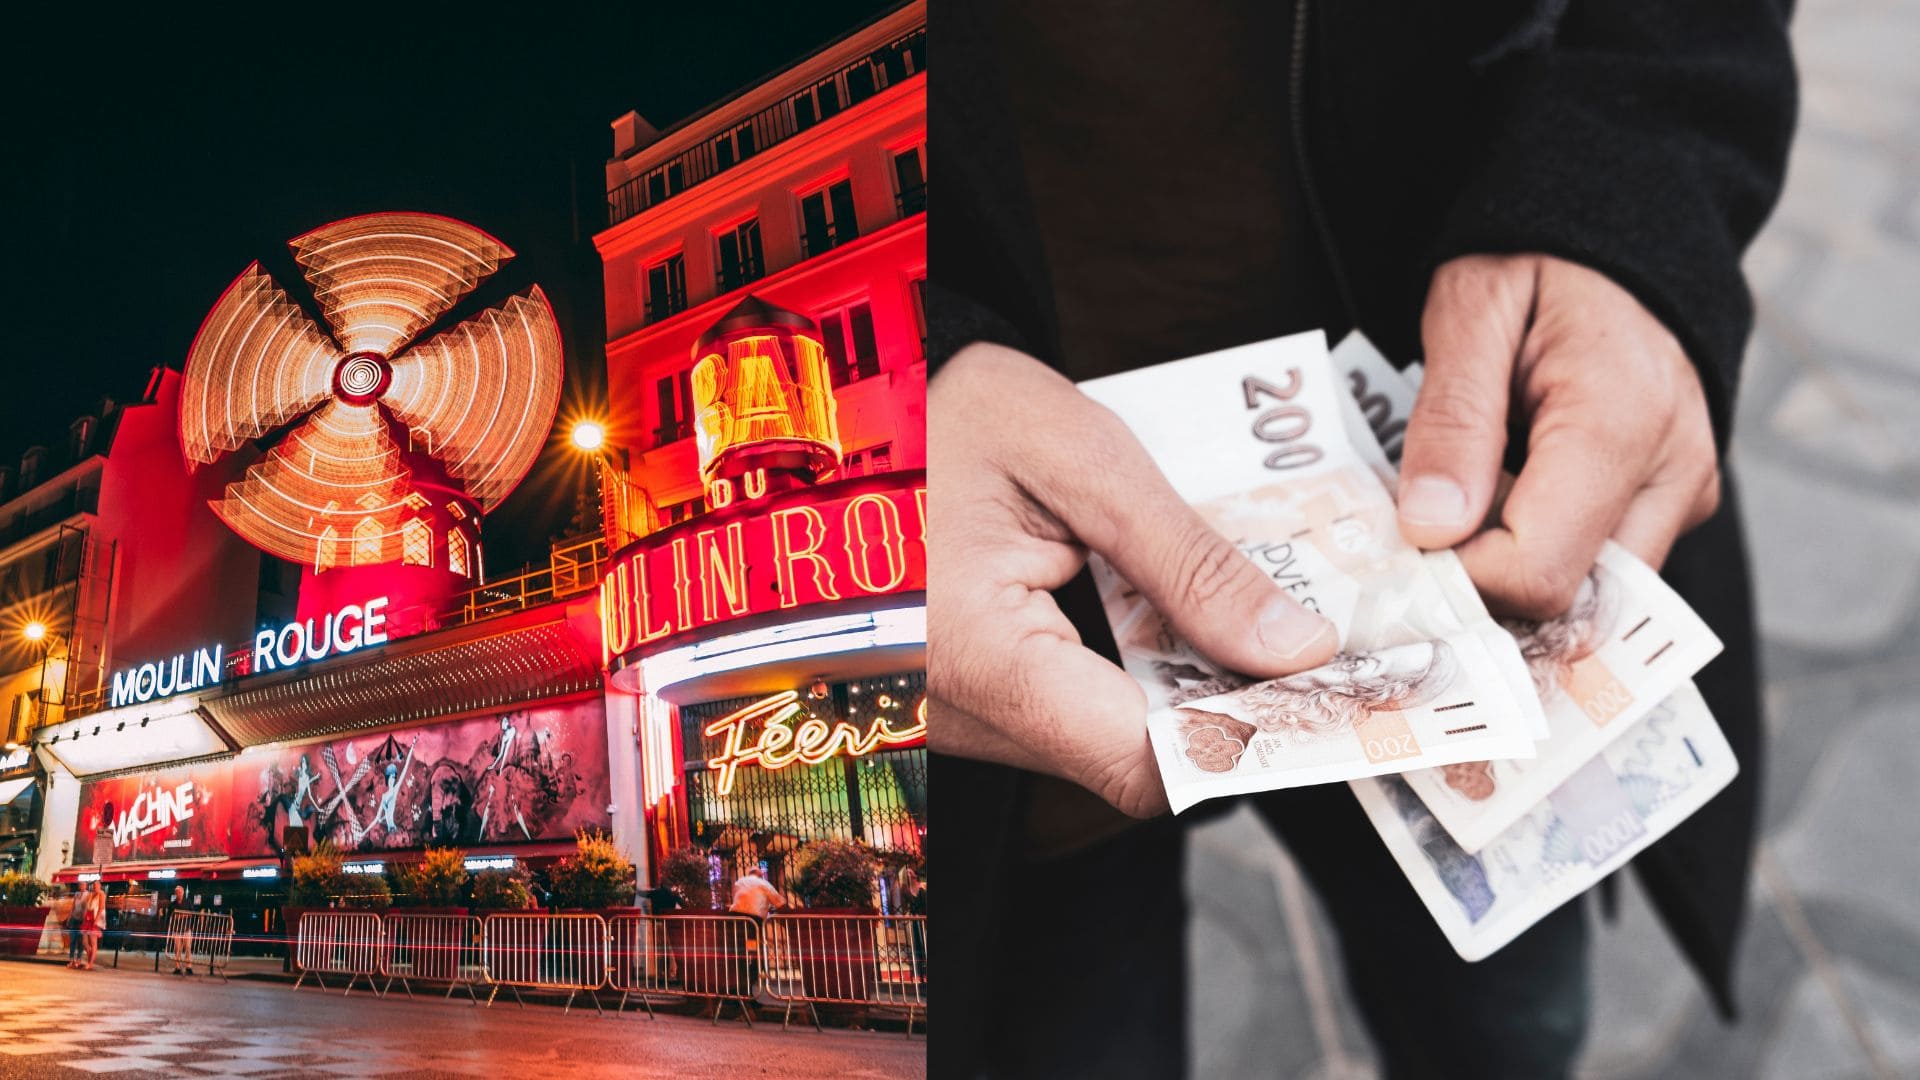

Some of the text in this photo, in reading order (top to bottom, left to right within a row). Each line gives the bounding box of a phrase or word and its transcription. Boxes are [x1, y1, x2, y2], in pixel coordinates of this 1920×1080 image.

[1241, 367, 1325, 470] 200
[711, 467, 766, 509] DU
[111, 596, 389, 707] MOULIN ROUGE
[1583, 680, 1633, 723] 200
[1366, 733, 1418, 760] 200
[108, 781, 194, 848] MACHINE
[1584, 809, 1642, 861] 1000
